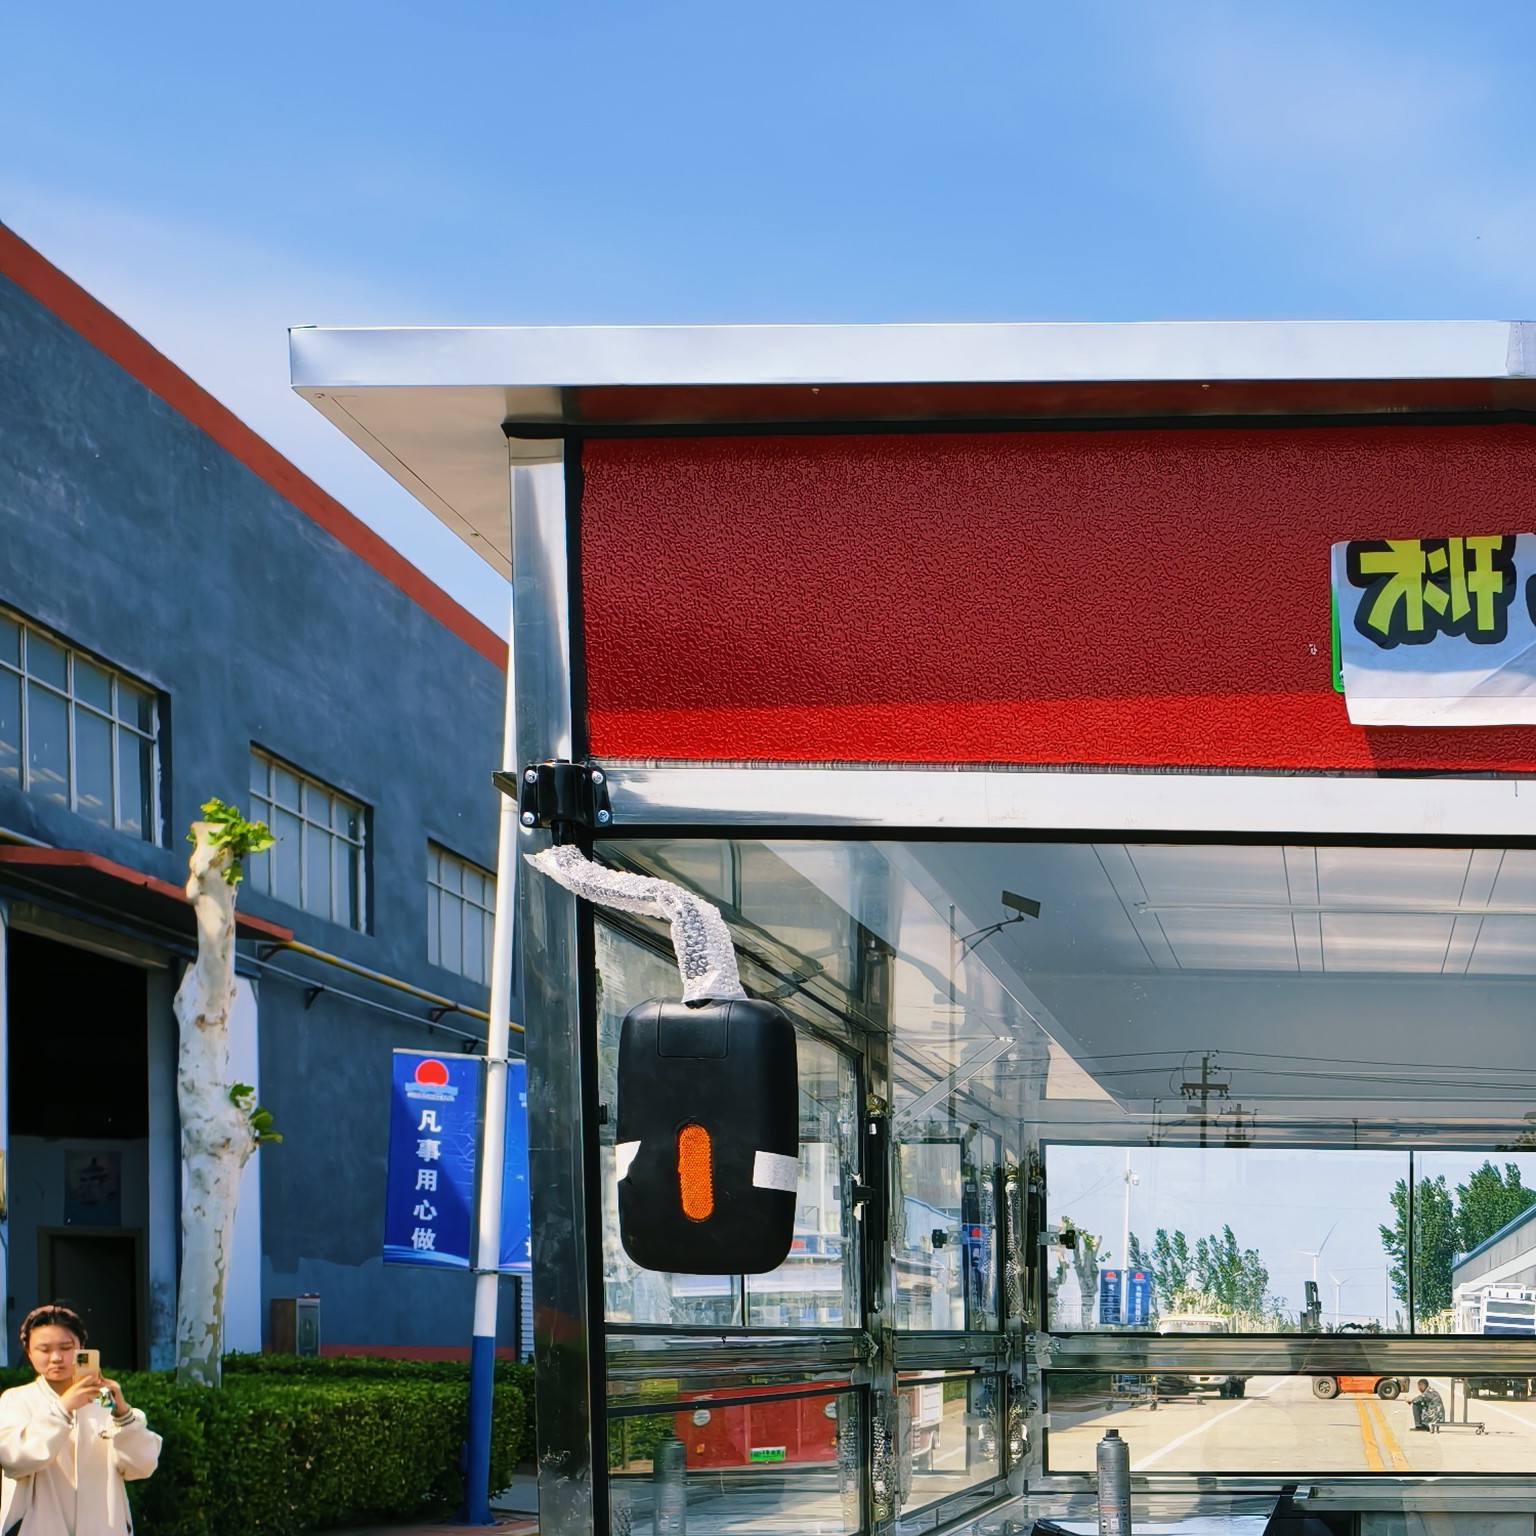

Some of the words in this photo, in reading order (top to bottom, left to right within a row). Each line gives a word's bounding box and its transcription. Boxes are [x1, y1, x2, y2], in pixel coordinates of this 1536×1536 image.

[411, 1109, 442, 1250] 凡事用心做
